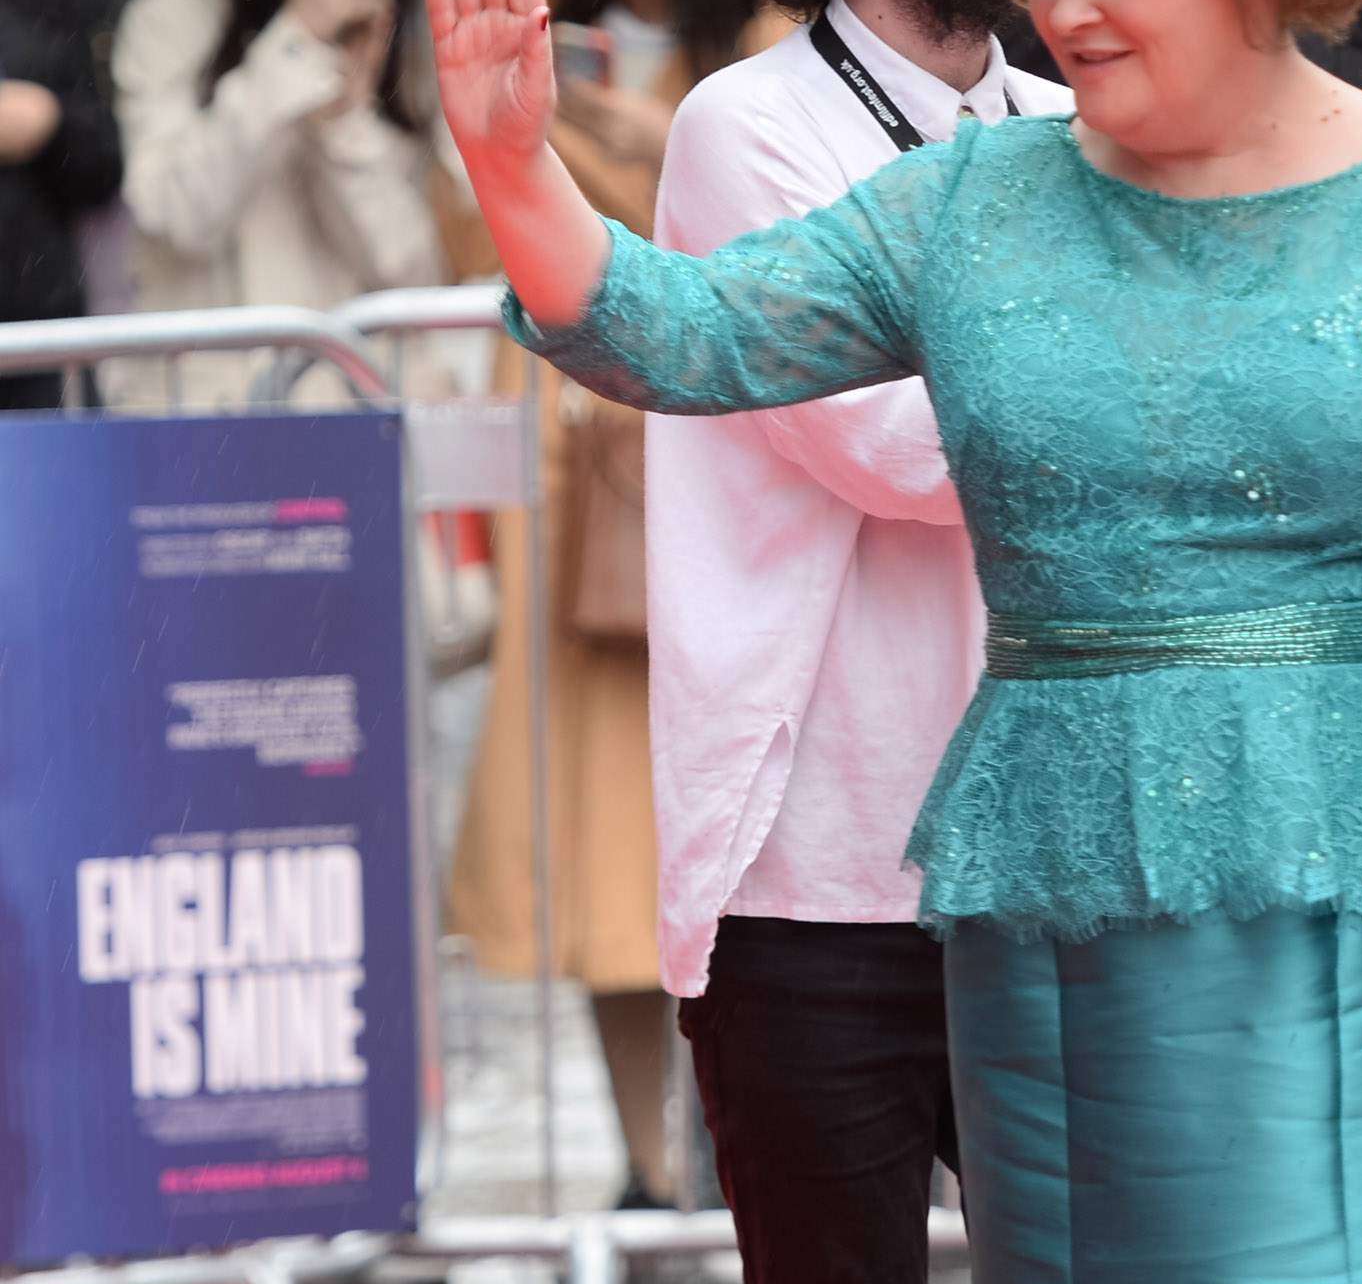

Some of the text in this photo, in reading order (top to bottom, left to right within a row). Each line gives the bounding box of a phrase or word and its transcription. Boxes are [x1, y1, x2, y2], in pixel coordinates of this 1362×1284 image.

[840, 58, 900, 128] edfilmfest.org.uk
[77, 845, 363, 984] ENGLAND
[130, 966, 367, 1098] IS MINE
